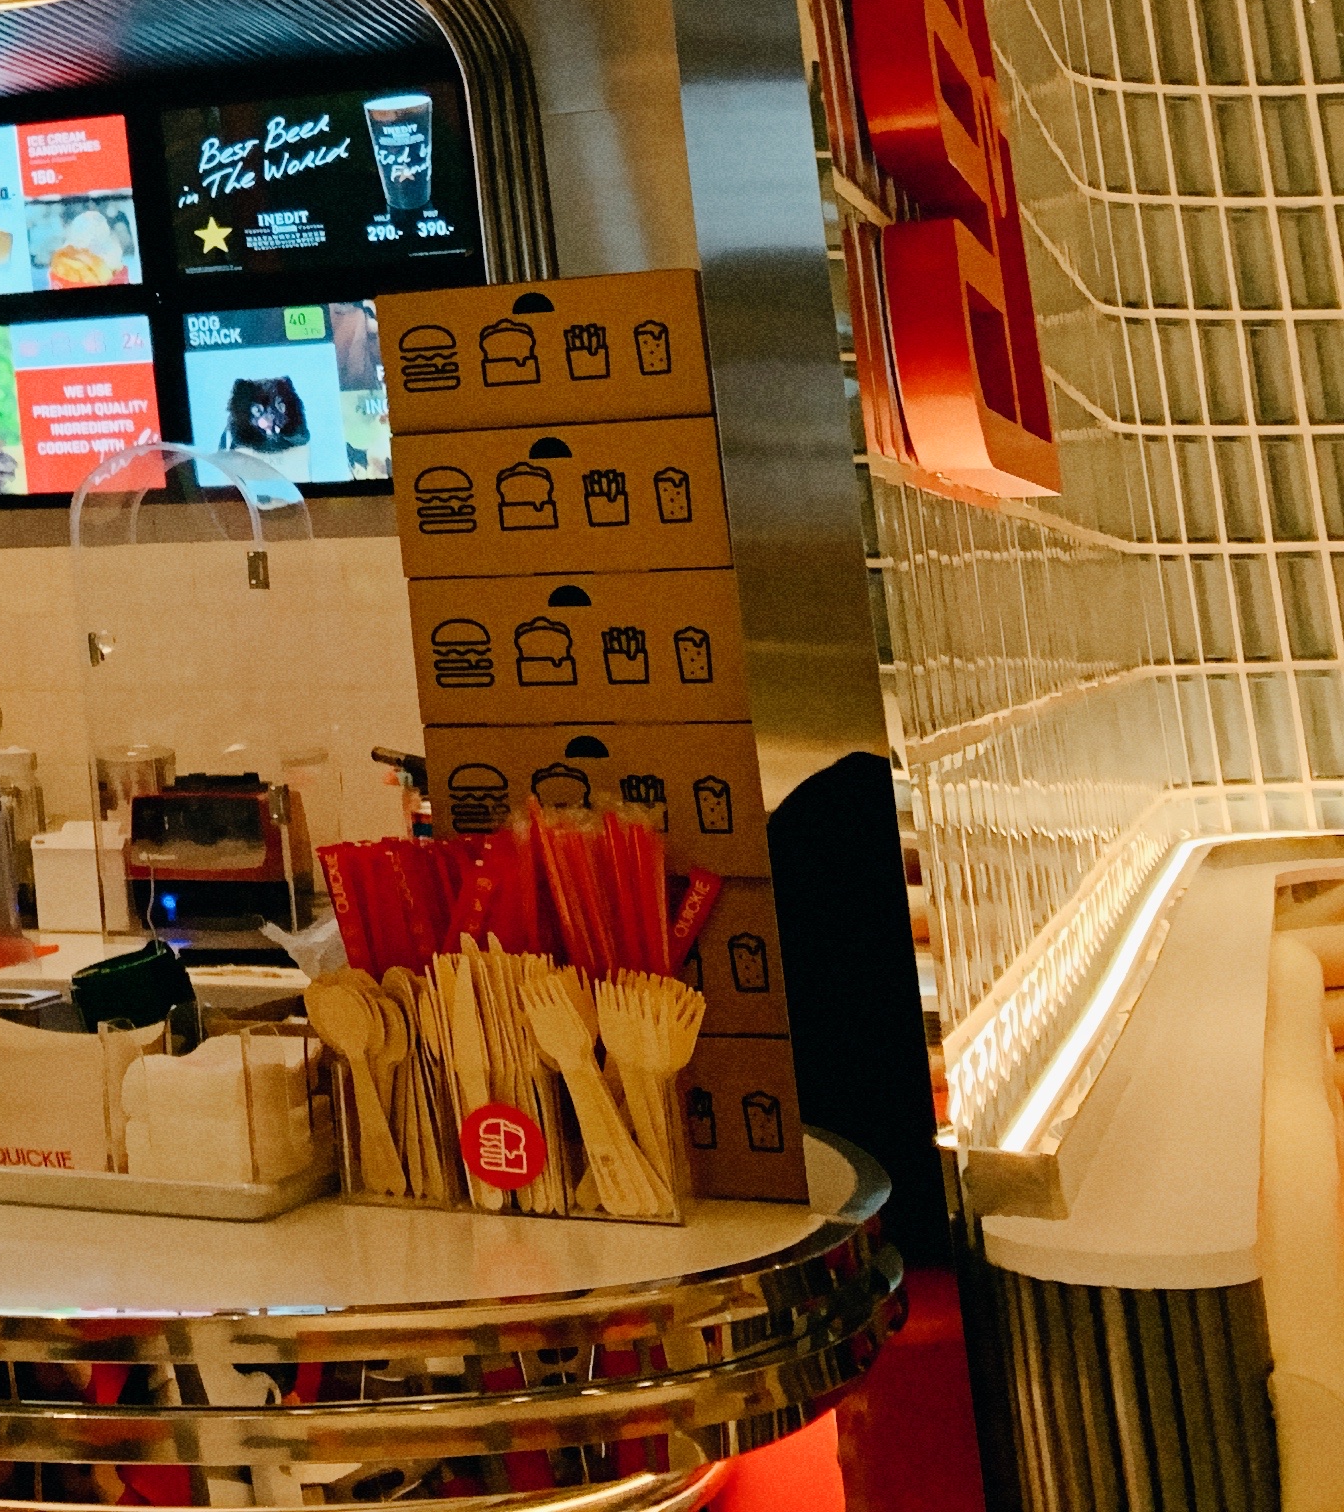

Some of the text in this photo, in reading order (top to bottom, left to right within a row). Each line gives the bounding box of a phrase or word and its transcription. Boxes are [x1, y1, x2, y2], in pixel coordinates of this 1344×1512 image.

[202, 162, 256, 198] The
[257, 210, 309, 227] INEDIT
[188, 316, 220, 331] DOG
[189, 328, 242, 346] SNACK
[63, 383, 113, 399] WE USE
[32, 399, 148, 419] PREMIUM QUALITY
[50, 419, 135, 436] INGREDIENTS
[37, 440, 90, 456] COOKED
